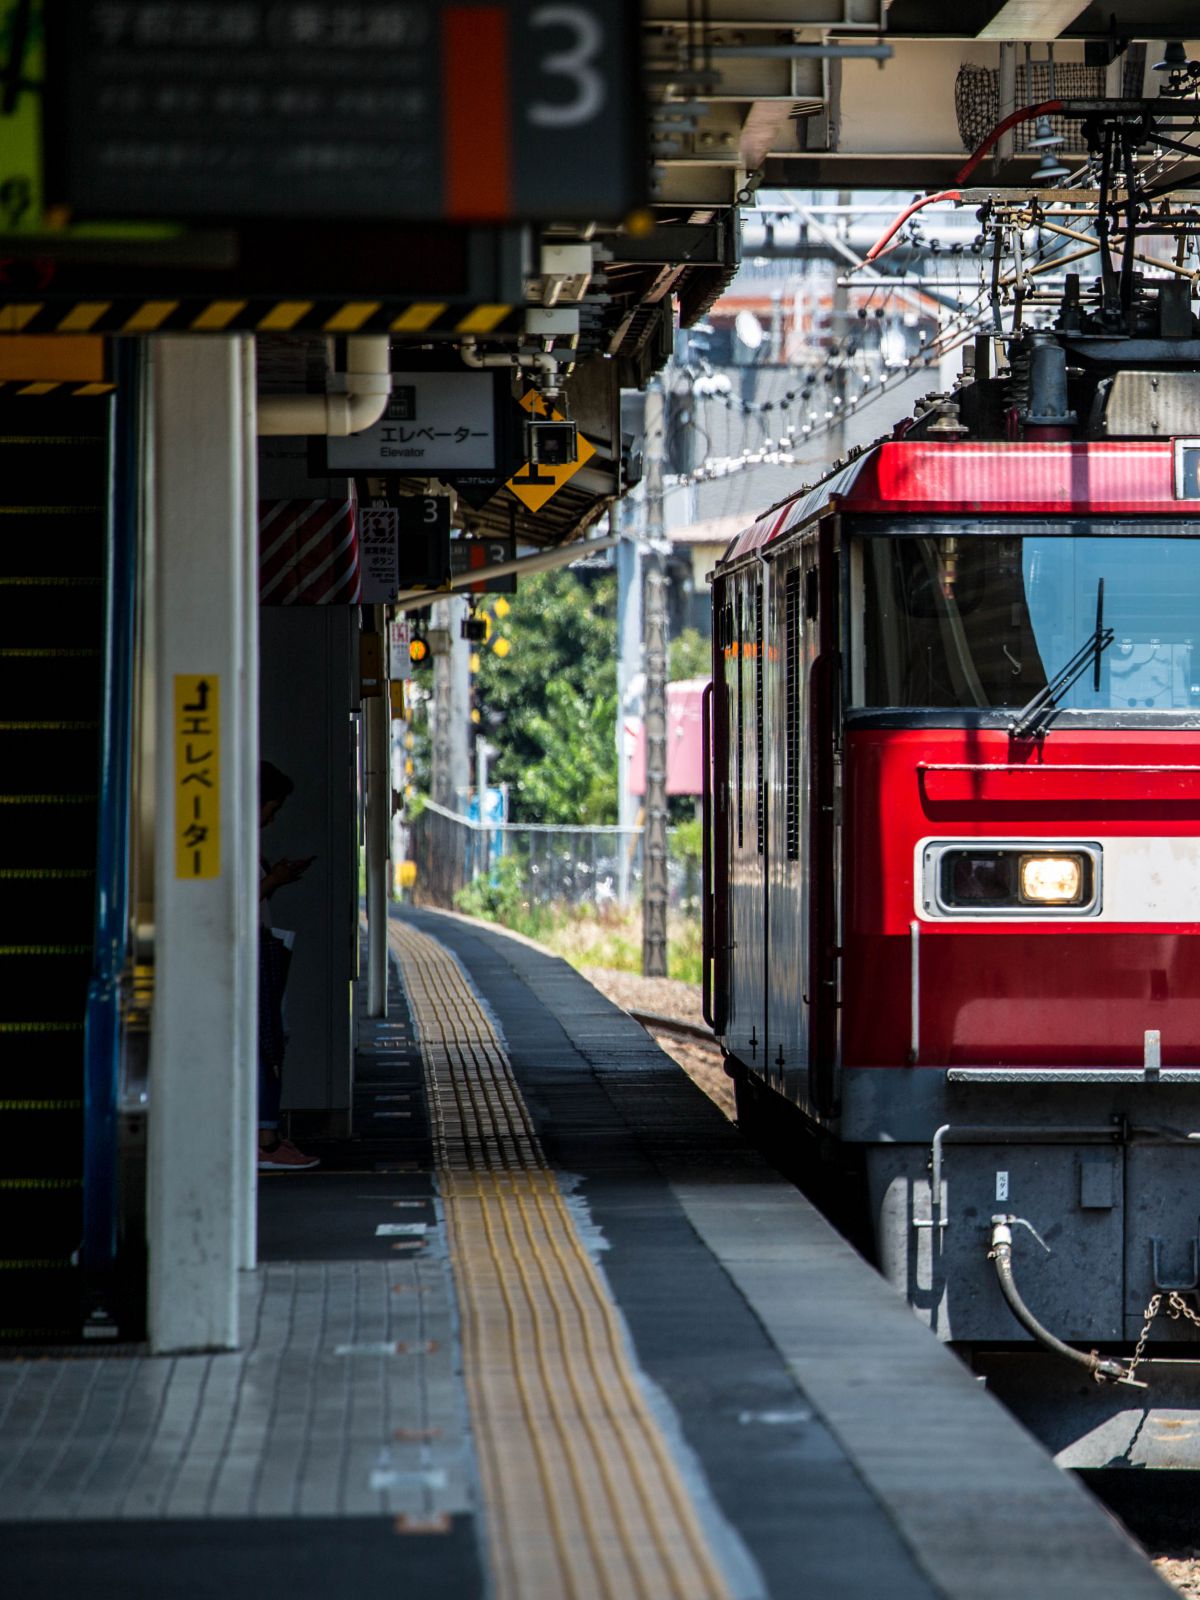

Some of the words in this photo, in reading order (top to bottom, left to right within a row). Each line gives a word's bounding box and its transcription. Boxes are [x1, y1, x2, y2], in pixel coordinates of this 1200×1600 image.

[526, 5, 607, 127] 3
[380, 426, 489, 443] エレベーター
[380, 447, 426, 458] Elevator
[423, 498, 438, 523] 3
[180, 715, 213, 876] エレベーター
